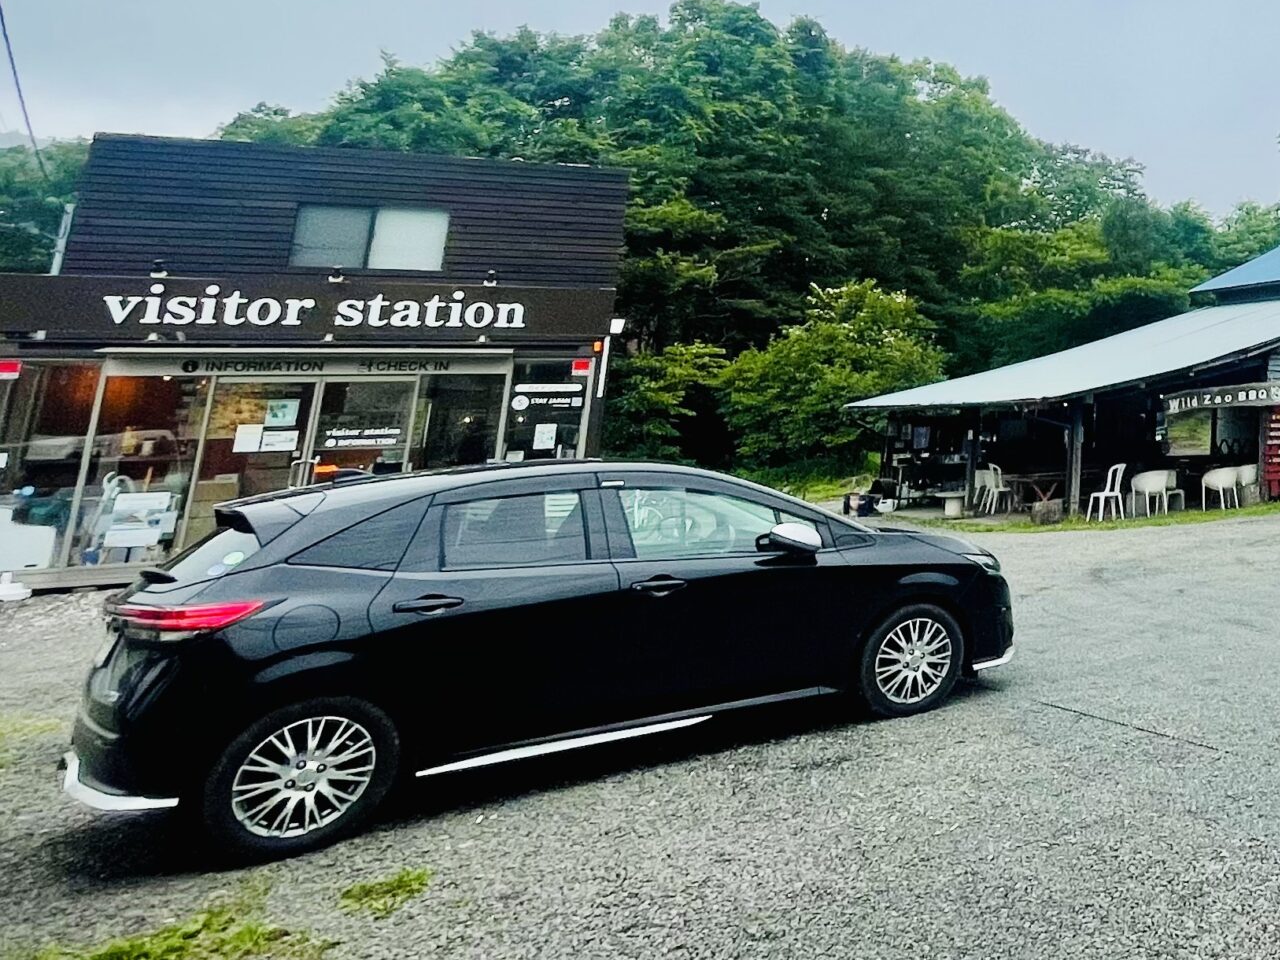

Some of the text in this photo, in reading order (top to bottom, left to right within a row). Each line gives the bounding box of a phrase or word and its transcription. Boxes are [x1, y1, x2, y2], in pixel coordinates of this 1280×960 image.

[103, 285, 526, 329] visitor station
[205, 360, 325, 372] INFORMATION
[376, 360, 450, 372] CHECK IN
[1168, 388, 1267, 414] Wild Zao BBQ
